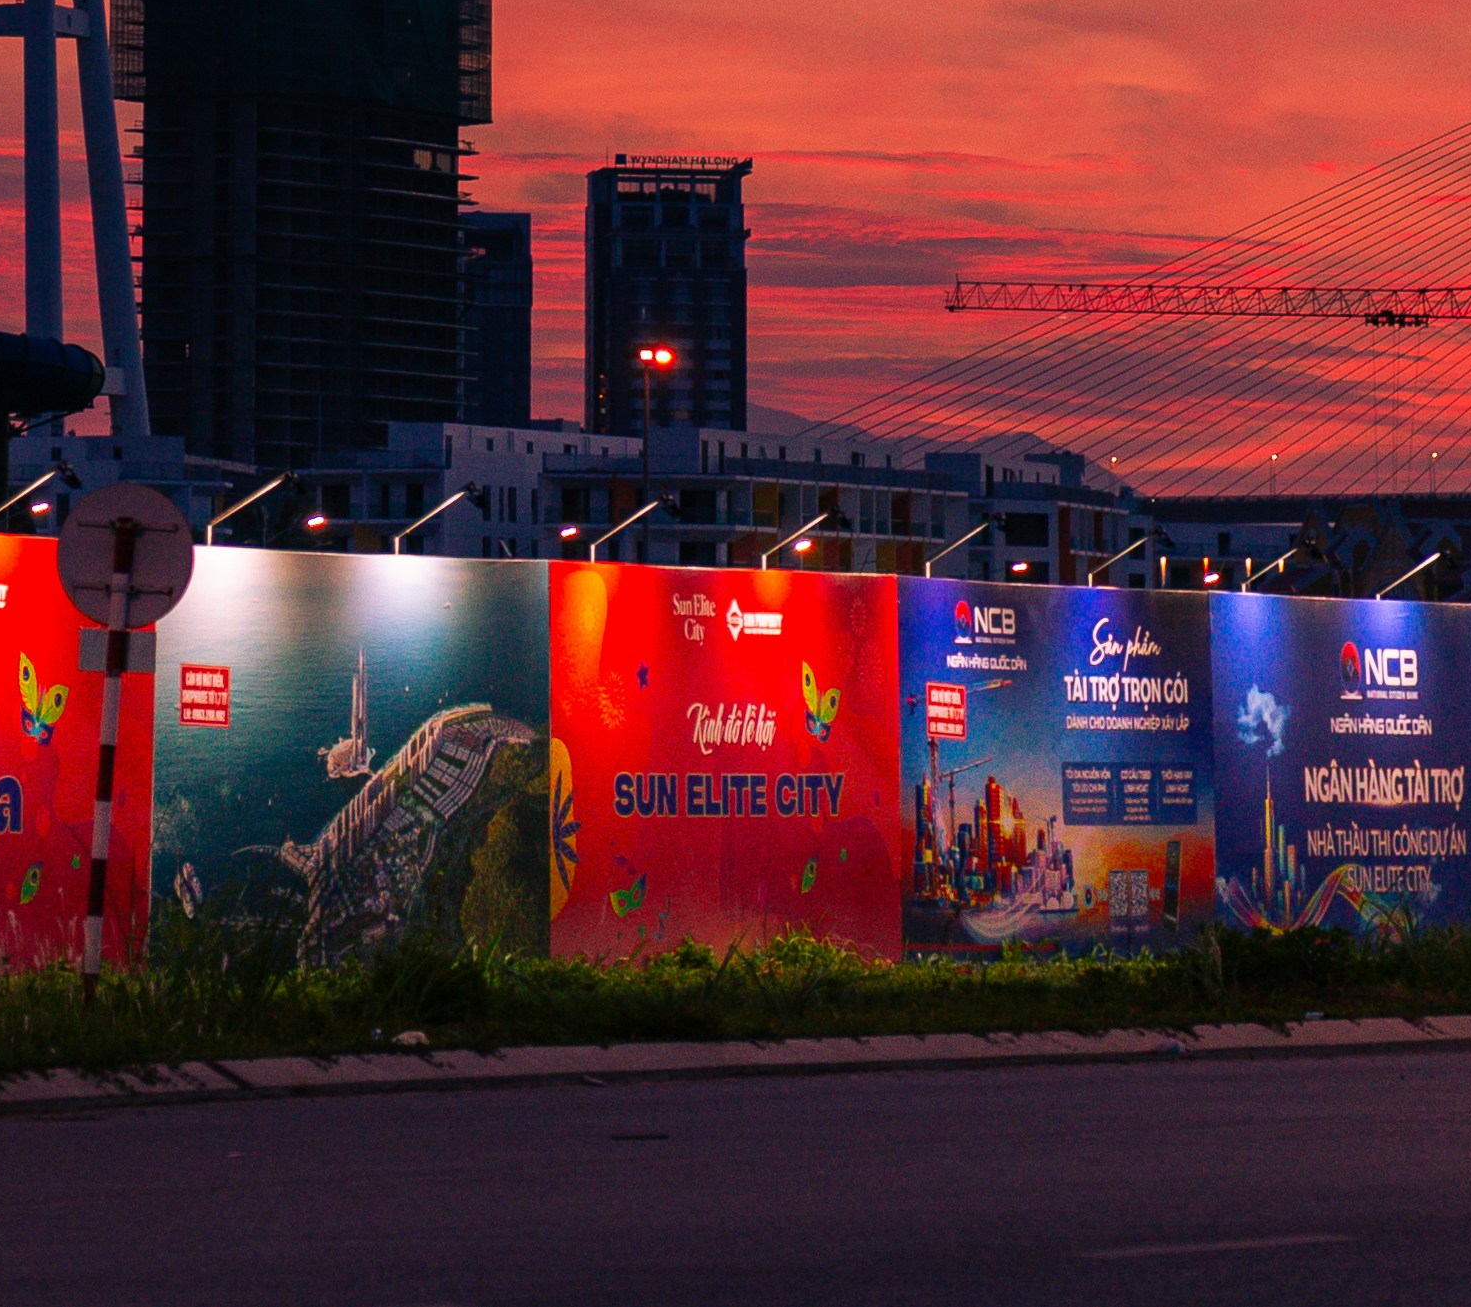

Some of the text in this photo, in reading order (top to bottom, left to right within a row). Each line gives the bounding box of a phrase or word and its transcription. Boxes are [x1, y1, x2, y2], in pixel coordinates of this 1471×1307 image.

[631, 155, 738, 165] WYNDHAM HALONG
[673, 593, 716, 617] Sun Elite
[684, 618, 705, 646] City
[974, 606, 1015, 634] NCB
[1090, 617, 1161, 672] Sản phẩm
[947, 652, 1026, 670] NGÂN HÀNG QUỐC DÂN
[1364, 648, 1418, 686] NCB
[1064, 669, 1188, 711] TÀI TRỢ TRỌN GÓI
[687, 702, 776, 755] Kinh đô lễ hội
[1066, 713, 1087, 729] DÀNH
[1089, 716, 1105, 729] CHO
[1106, 716, 1132, 730] DOANH
[1134, 714, 1160, 733] NGHIỆP
[1161, 715, 1174, 731] XÂY
[1330, 712, 1432, 735] NGÂN HÀNG QUỐC DÂN
[613, 771, 844, 818] SUN ELITE CITY
[1304, 758, 1464, 811] NGÂN HÀNG TÀI TRỢ
[1307, 820, 1466, 861] NHÀ THẦU THI CÔNG DỰ ÁN
[1347, 865, 1431, 893] SUN ELITE CITY
